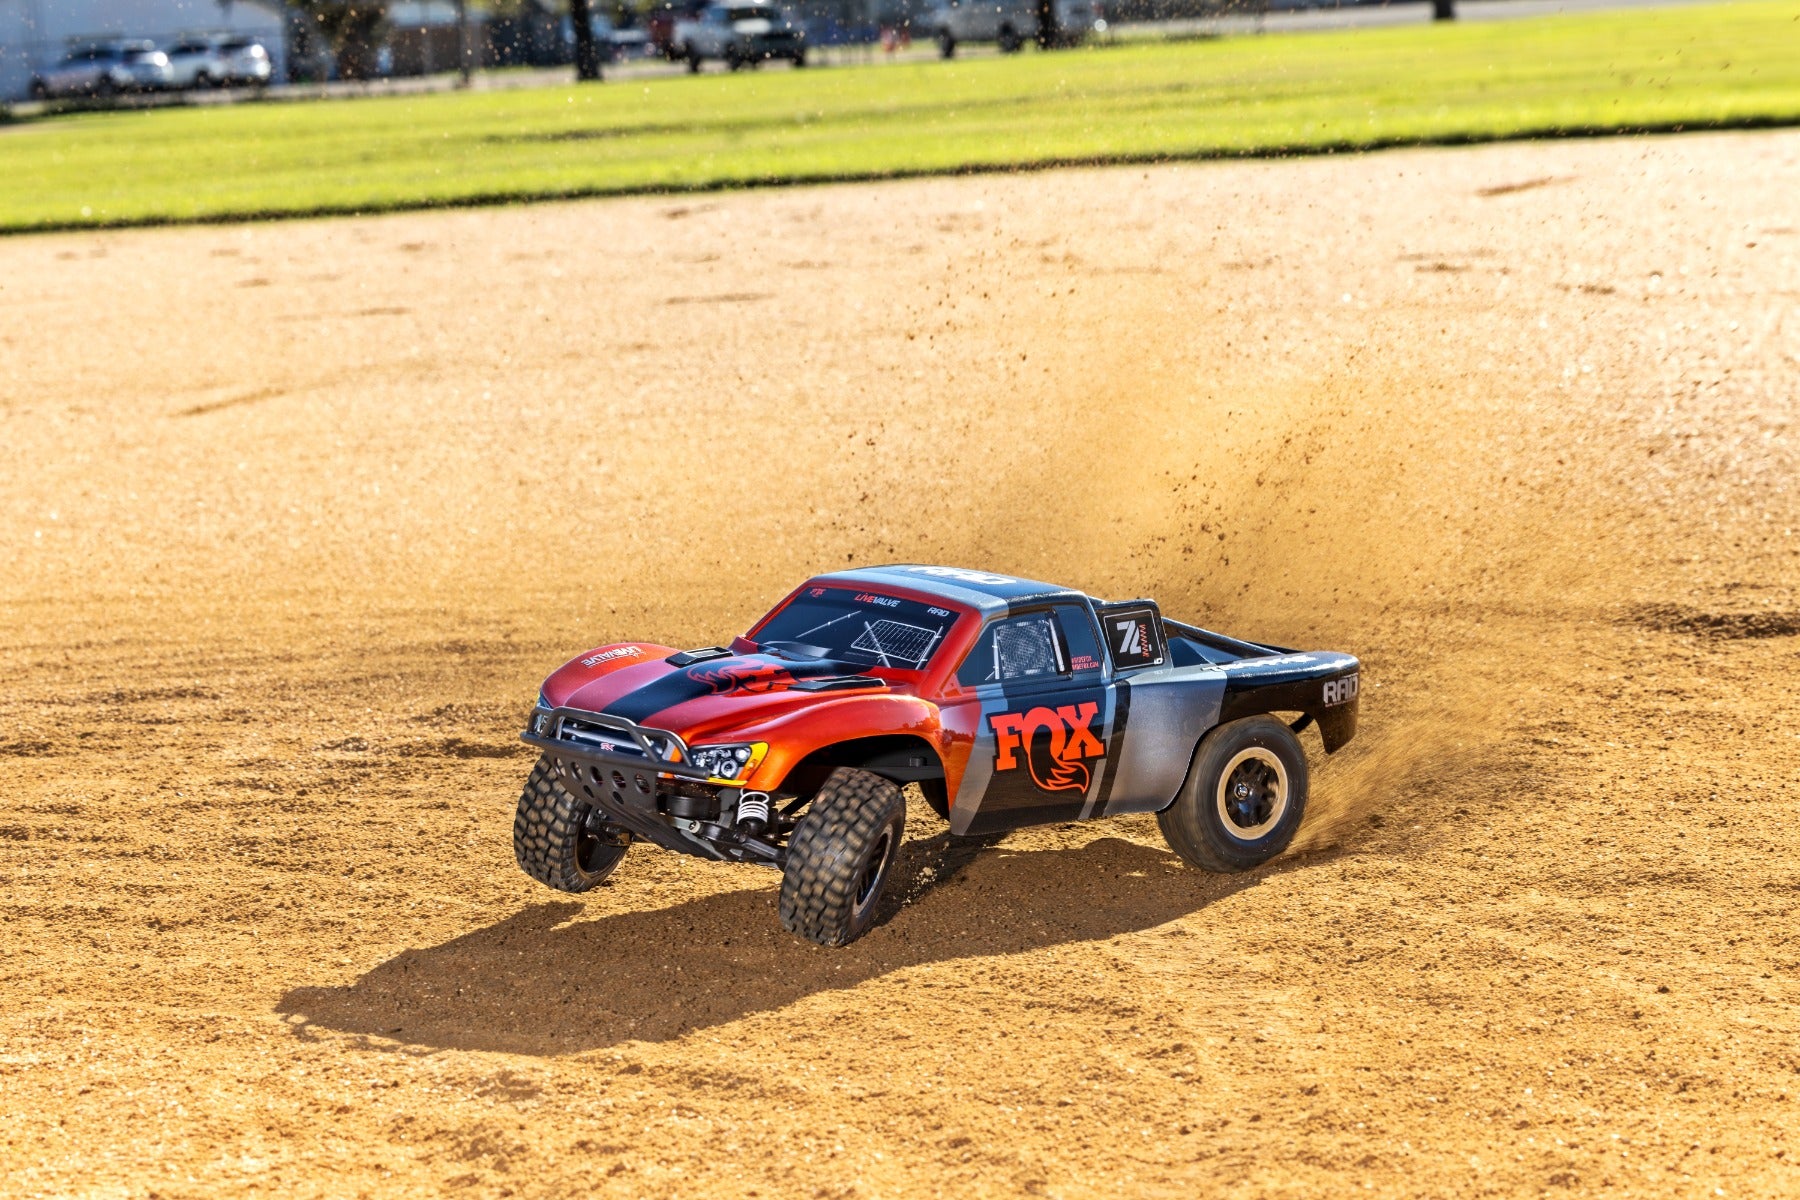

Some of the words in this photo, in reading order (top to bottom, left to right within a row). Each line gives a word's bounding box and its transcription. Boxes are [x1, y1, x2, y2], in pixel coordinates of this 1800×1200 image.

[927, 606, 950, 617] RAD
[1323, 672, 1359, 705] RAD
[989, 701, 1105, 794] FOX
